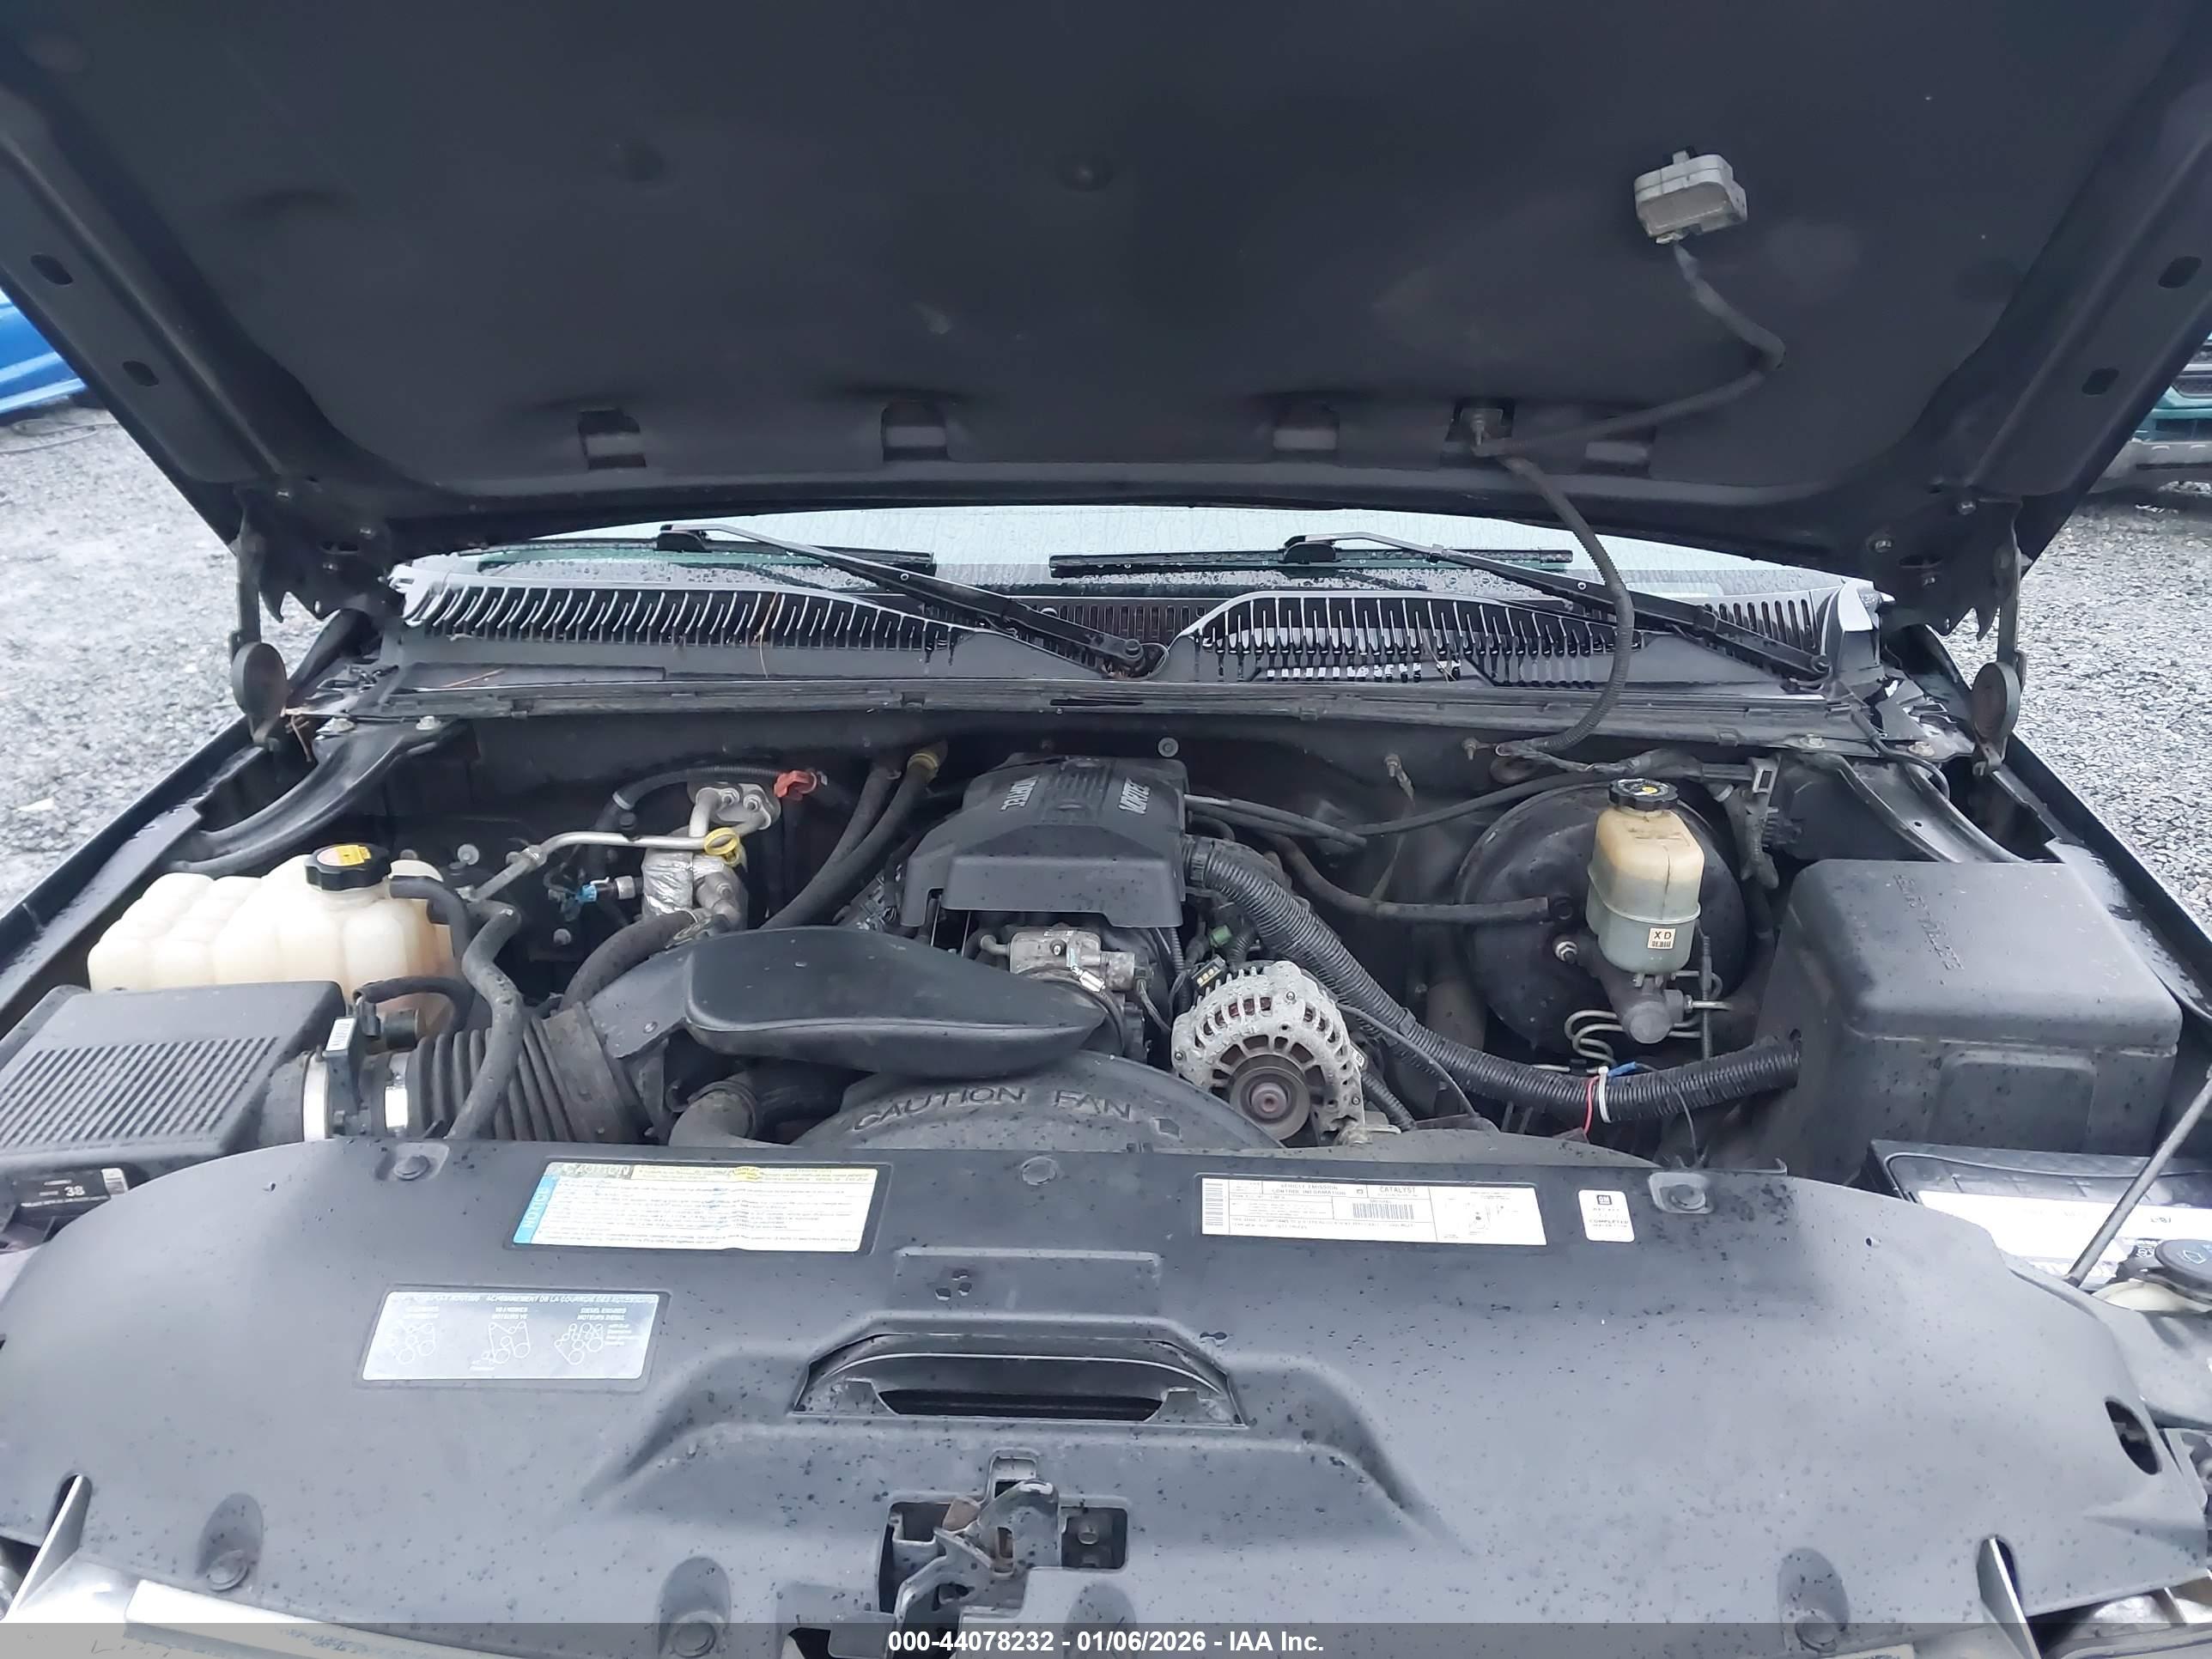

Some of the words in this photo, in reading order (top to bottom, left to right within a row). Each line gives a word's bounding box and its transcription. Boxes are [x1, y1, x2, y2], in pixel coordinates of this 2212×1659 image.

[1117, 777, 1151, 815] VORTEC
[852, 1085, 1027, 1132] CAUTION
[1053, 1089, 1132, 1121] FAN
[562, 1164, 632, 1176] CAUTION
[64, 1185, 86, 1197] 38
[522, 1187, 550, 1229] NOTICE
